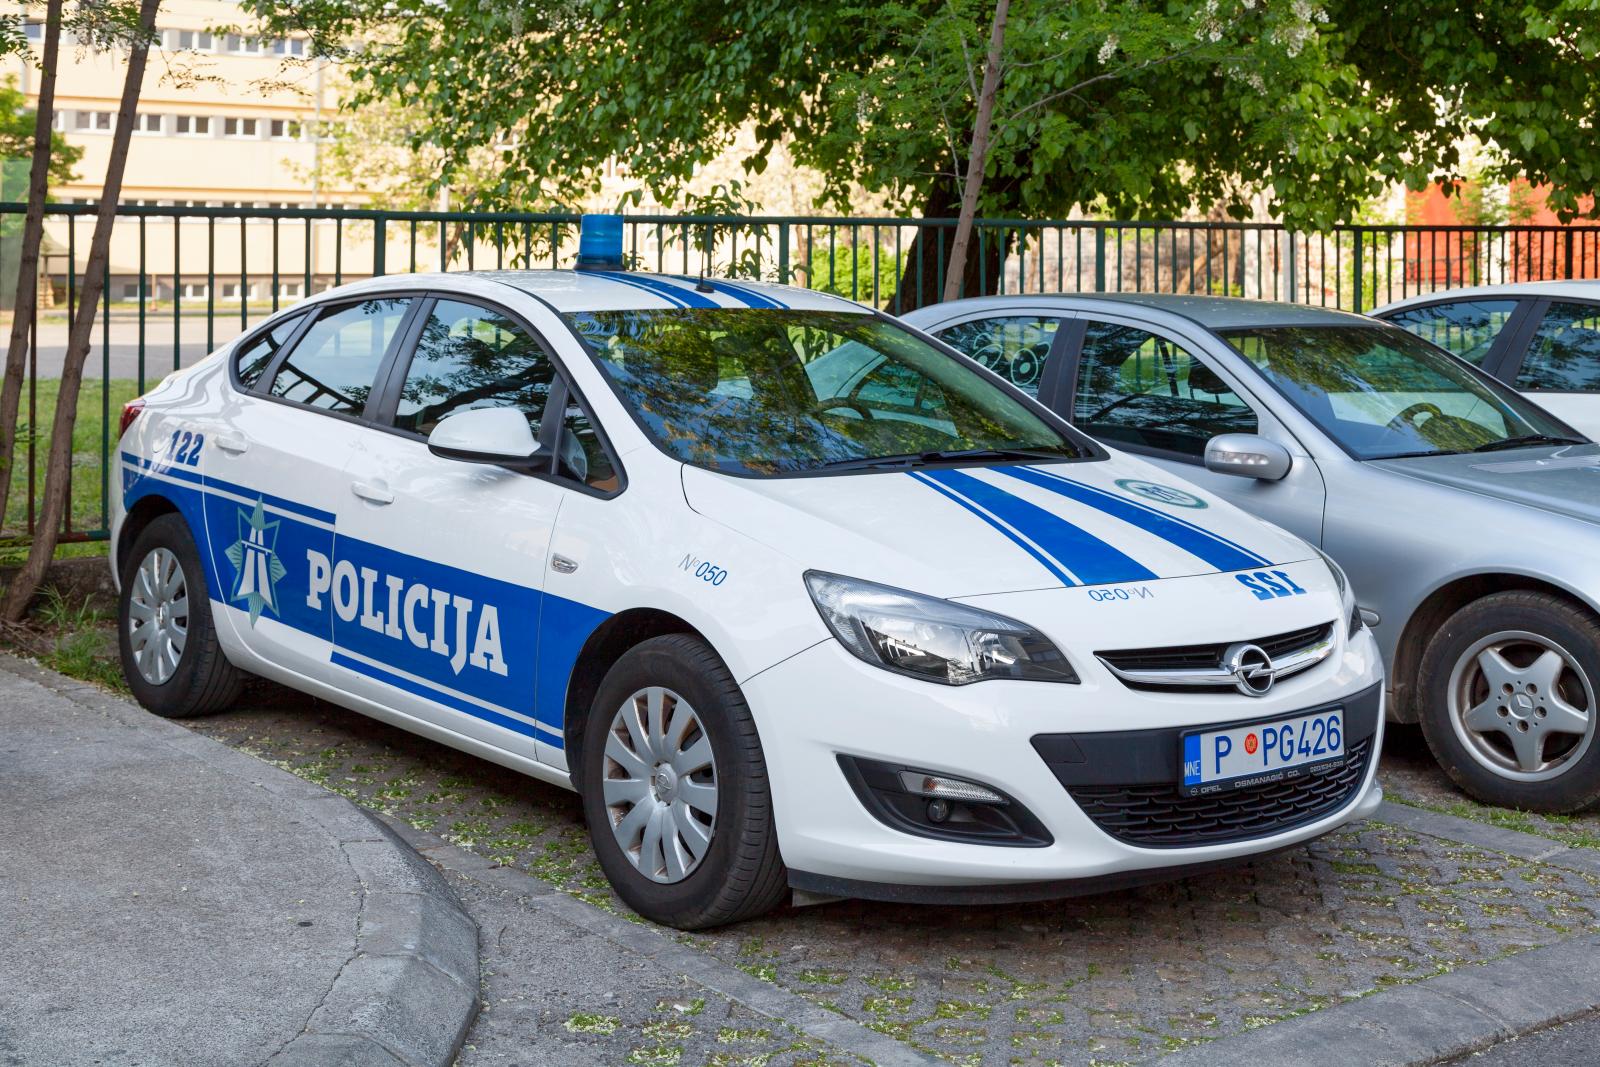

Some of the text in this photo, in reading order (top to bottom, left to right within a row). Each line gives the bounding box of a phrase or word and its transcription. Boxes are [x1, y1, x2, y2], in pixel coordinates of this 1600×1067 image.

[166, 429, 204, 466] 122
[306, 548, 509, 677] POLICIJA
[1215, 715, 1341, 774] P PG426
[1184, 759, 1200, 778] MNE
[1200, 785, 1222, 794] OPEL
